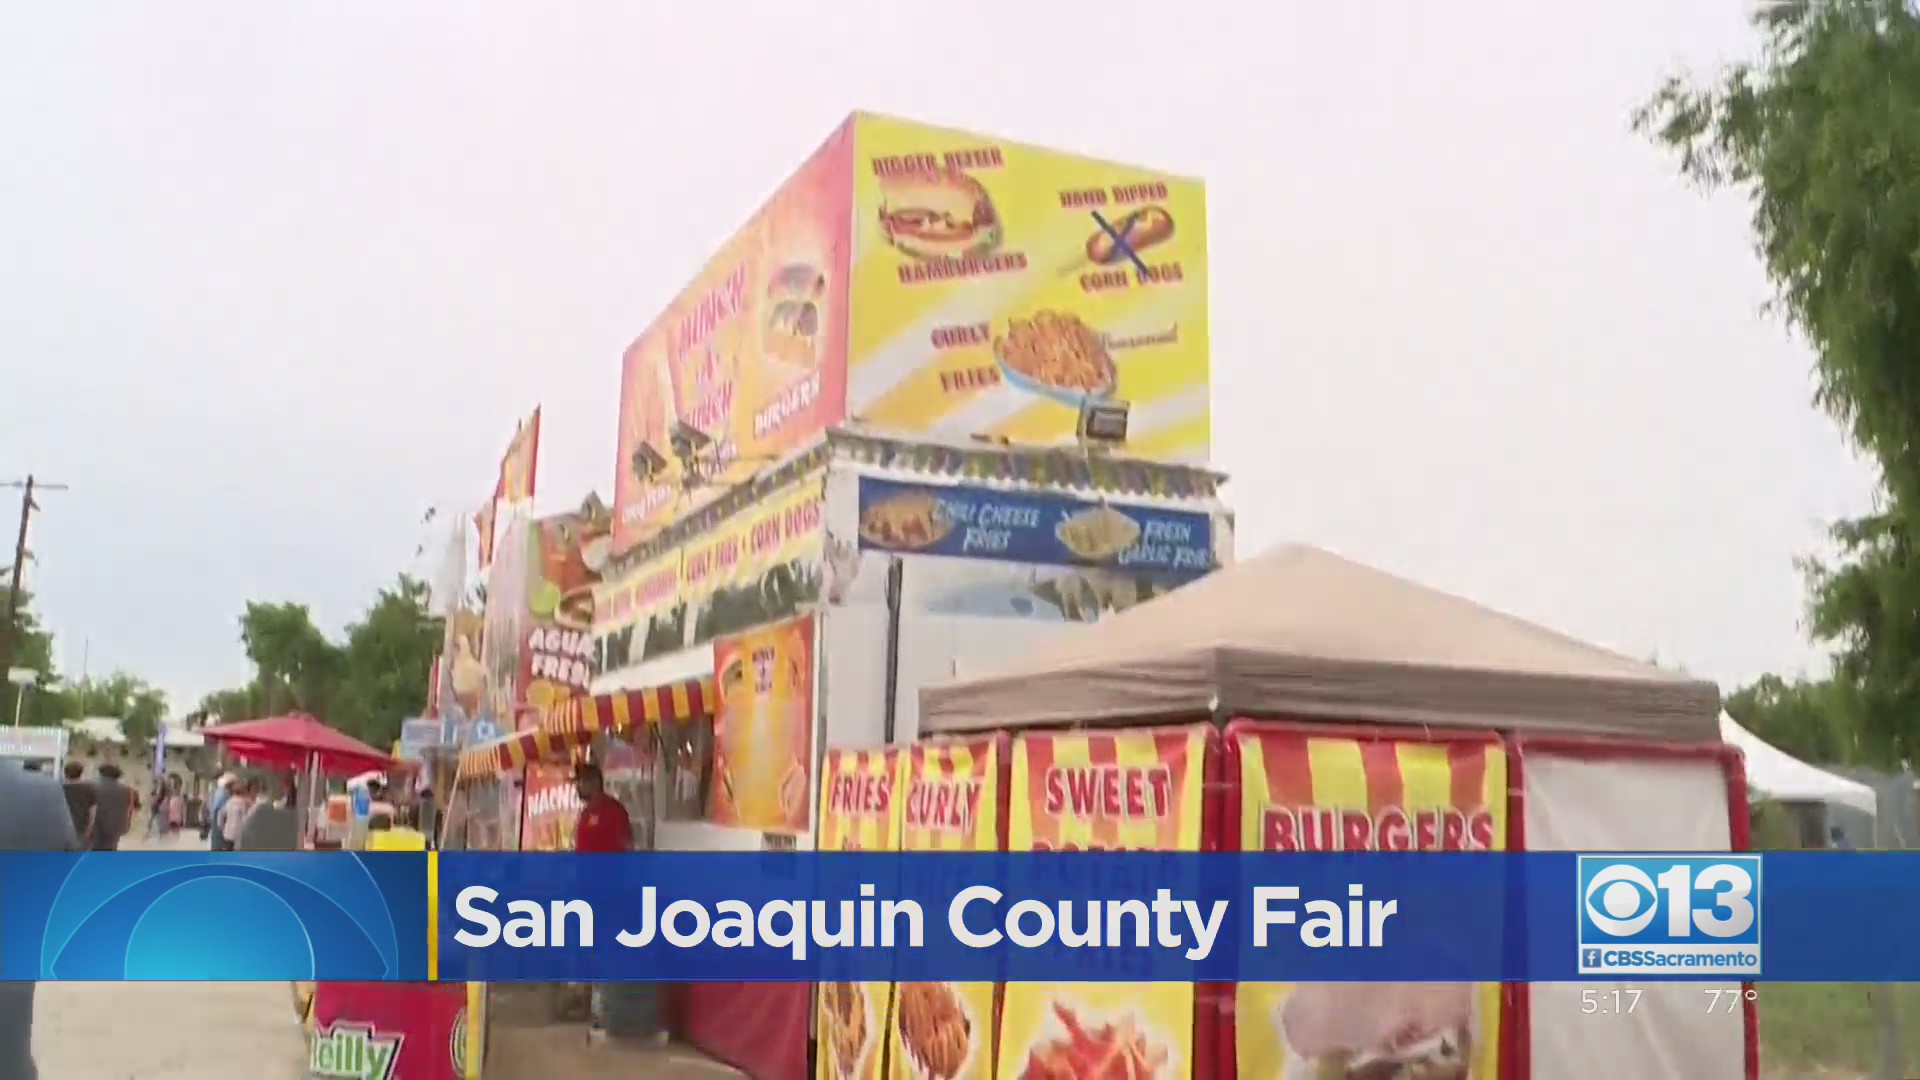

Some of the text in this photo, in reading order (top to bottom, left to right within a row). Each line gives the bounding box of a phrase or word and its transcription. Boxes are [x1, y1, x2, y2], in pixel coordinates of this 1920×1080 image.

[897, 252, 1027, 284] HAMBURGERS
[1080, 270, 1129, 293] CORN
[931, 322, 990, 350] CURLY
[939, 366, 1000, 393] FRIES
[978, 503, 1040, 528] CHEESE
[528, 626, 596, 659] AGUA
[830, 773, 891, 816] FRIES
[905, 781, 983, 829] CURLY
[1046, 766, 1172, 818] SWEET
[1263, 805, 1495, 853] BURGERS
